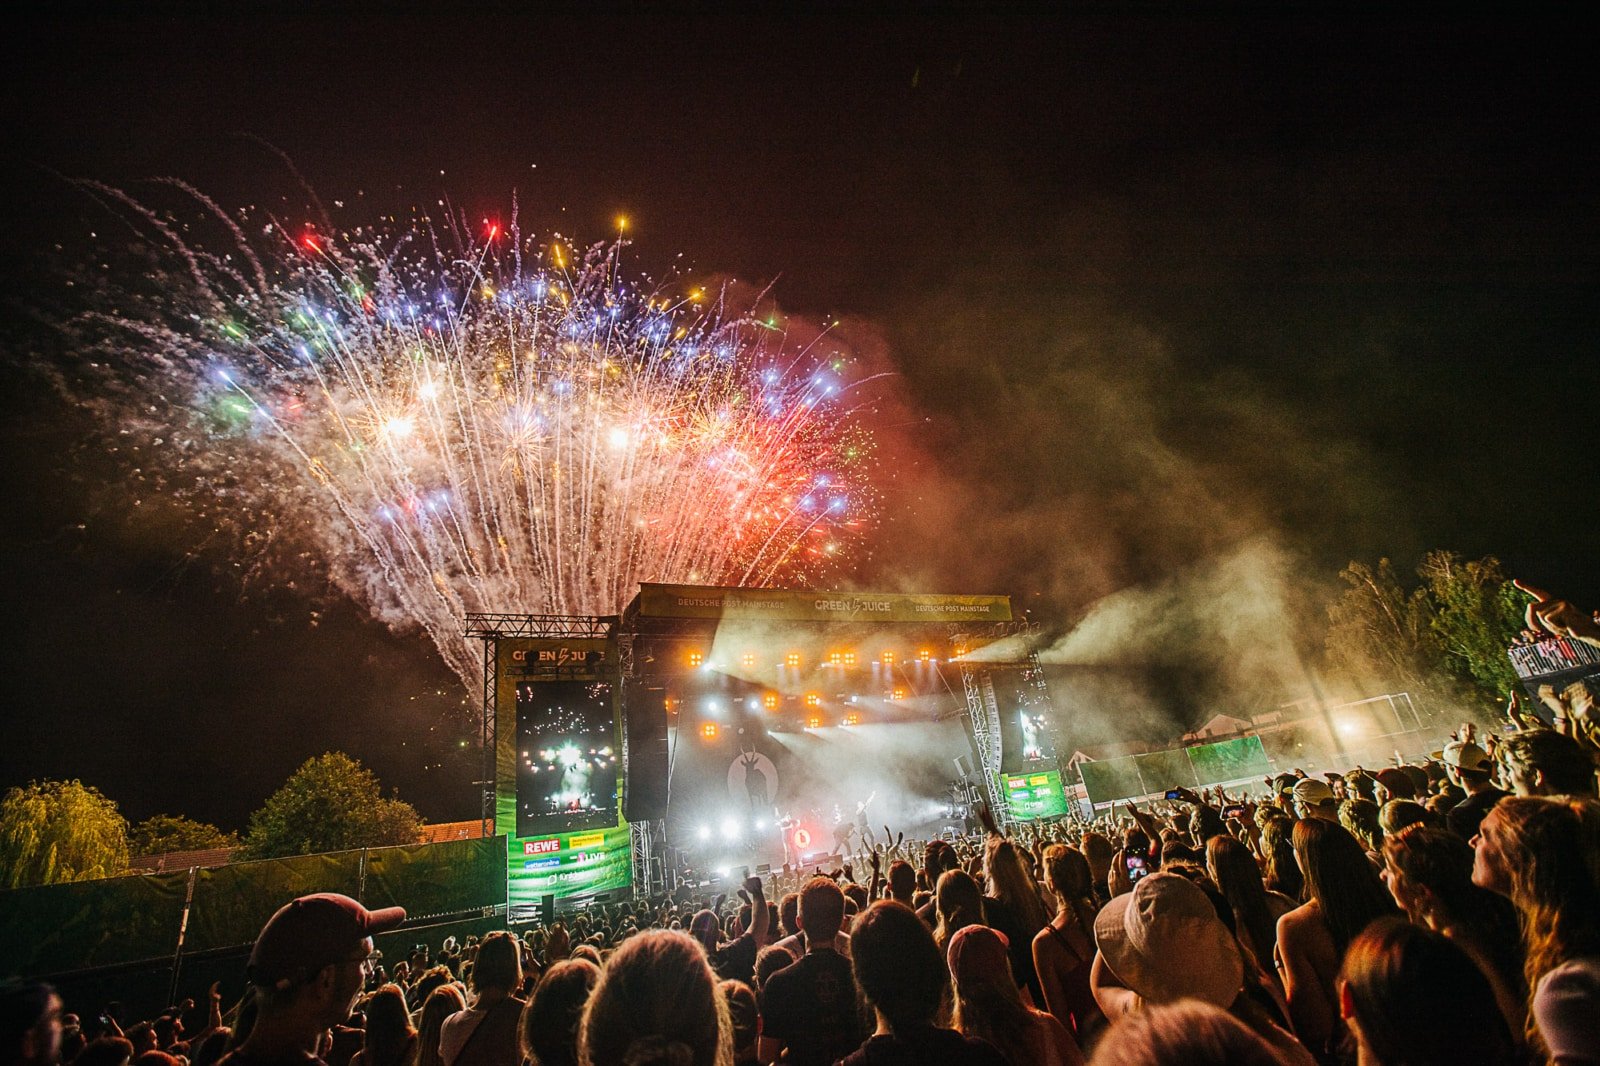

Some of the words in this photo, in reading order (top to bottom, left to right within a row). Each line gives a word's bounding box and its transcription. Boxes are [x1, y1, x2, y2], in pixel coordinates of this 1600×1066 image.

[678, 598, 720, 607] DEUTSCHE
[721, 600, 741, 608] POST
[742, 601, 785, 609] MAINSTAGE
[814, 600, 850, 611] GREEN
[862, 601, 891, 612] JUICE
[960, 605, 990, 613] MAINSTAGE
[512, 650, 556, 661] GEN
[570, 651, 606, 661] JUE
[525, 840, 559, 854] REWE
